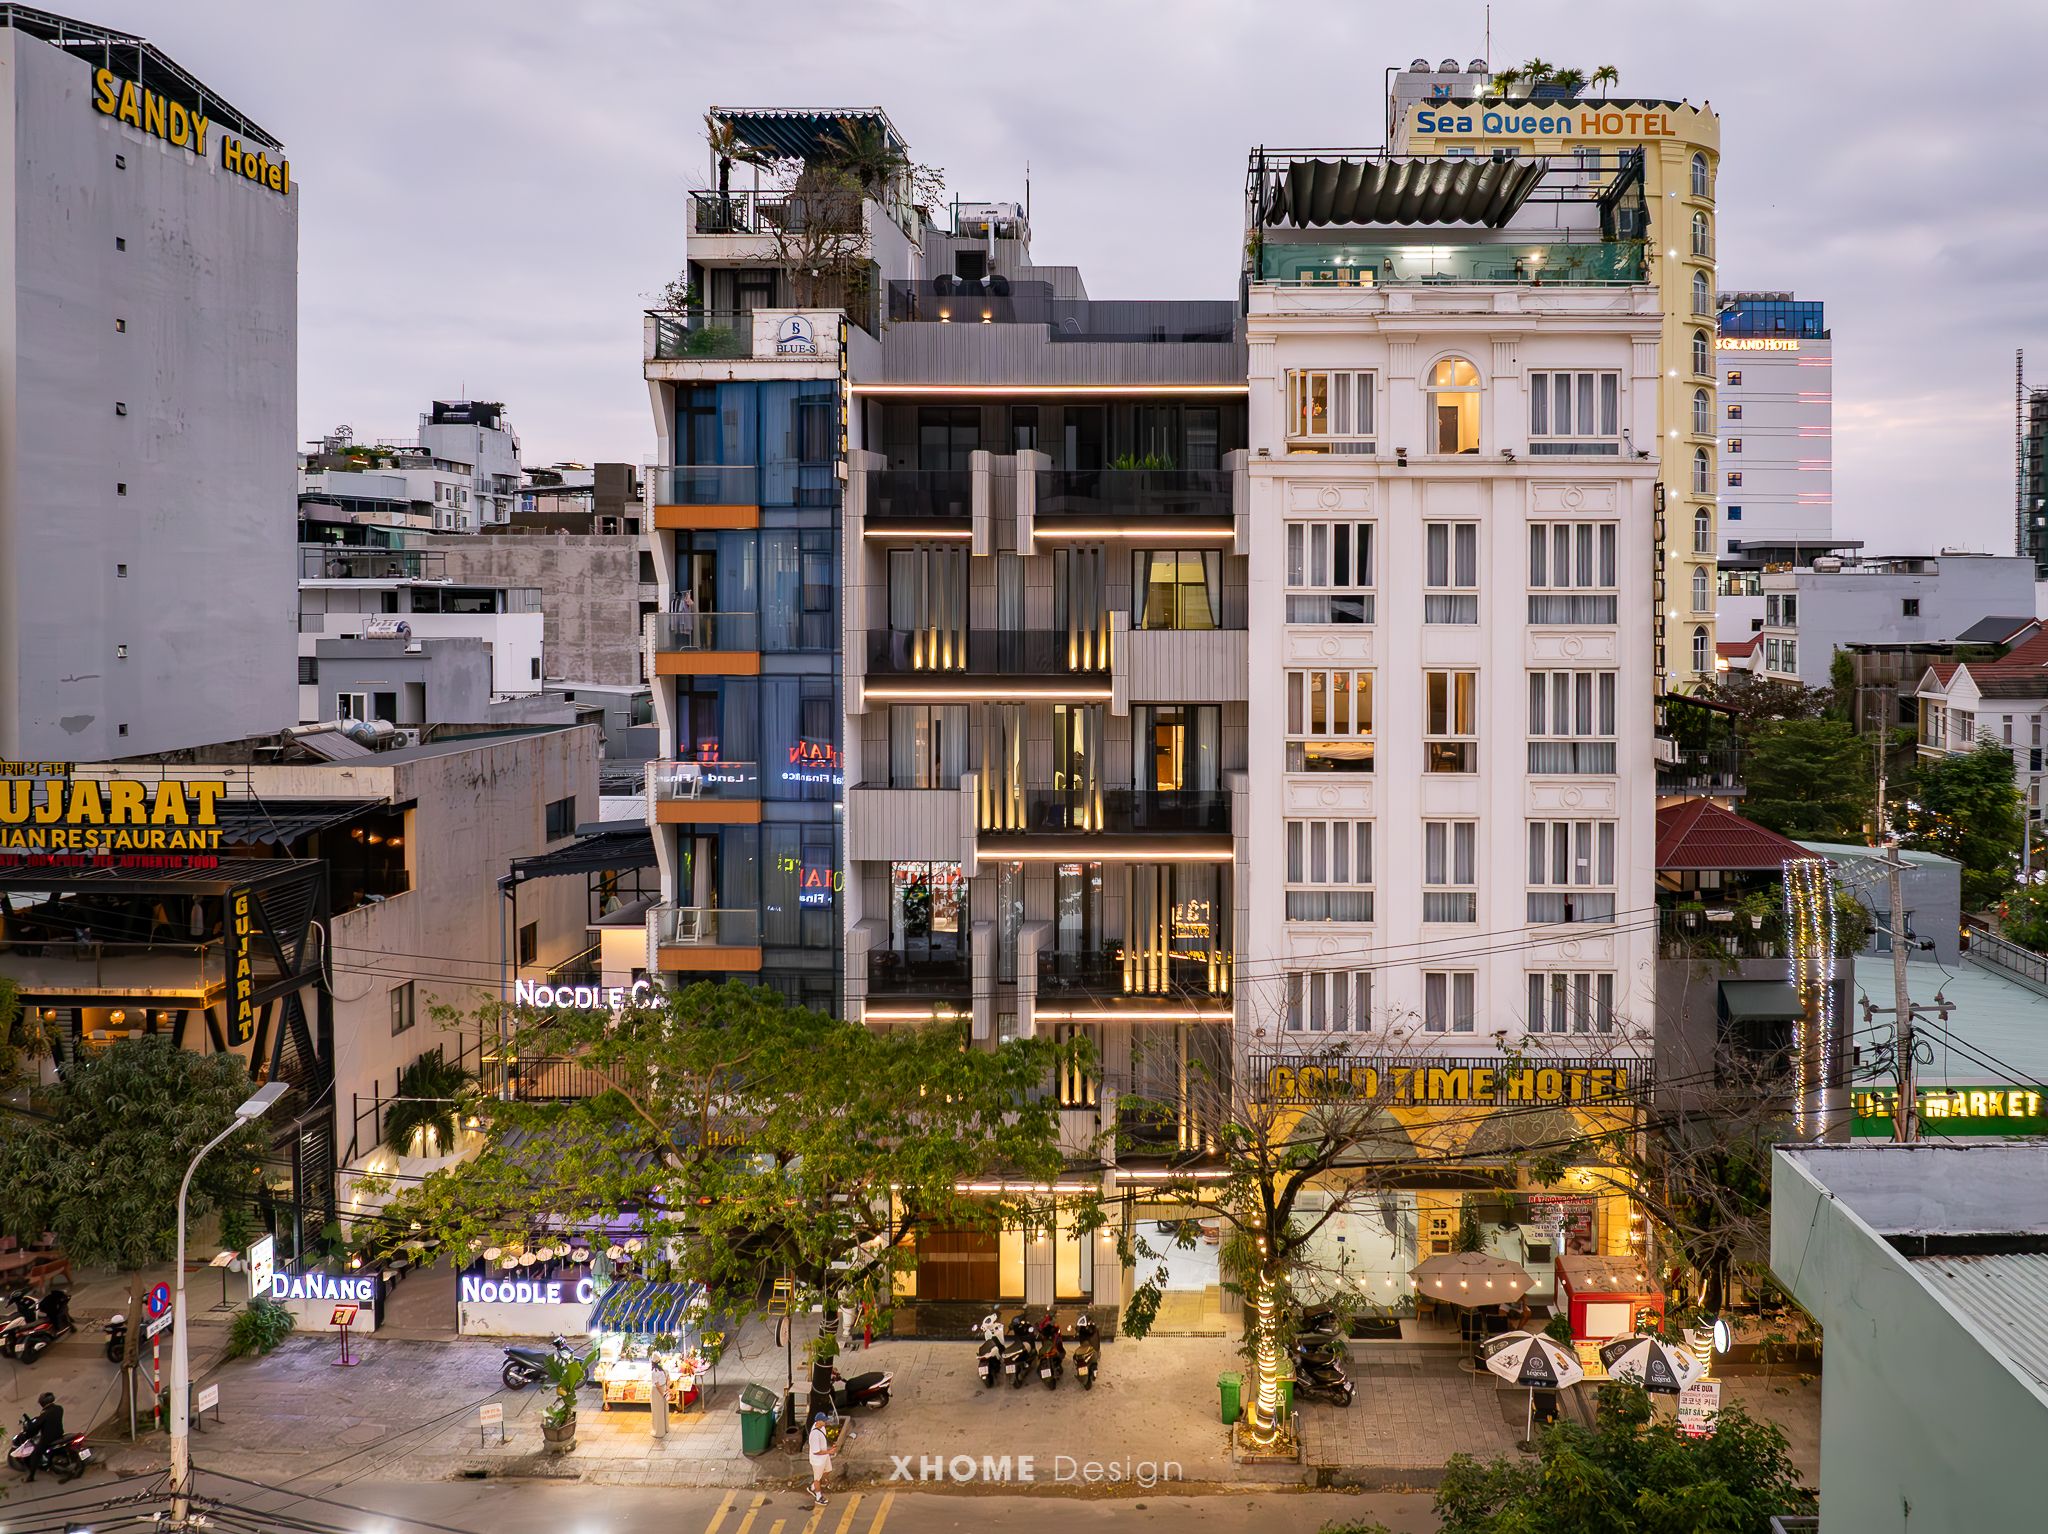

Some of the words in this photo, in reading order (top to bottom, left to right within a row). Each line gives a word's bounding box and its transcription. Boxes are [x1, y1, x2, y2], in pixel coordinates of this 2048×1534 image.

[97, 68, 208, 154] SANDY
[224, 135, 289, 194] Hotel
[1417, 111, 1472, 133] Sea
[1483, 112, 1571, 134] Queen
[1581, 113, 1675, 136] HOTEL
[776, 344, 816, 354] BLUE-S
[1722, 338, 1764, 350] GRAND
[1765, 339, 1799, 351] HOTEL
[52, 829, 223, 849] RESTAURANT
[235, 895, 251, 1040] GUJARAT
[1389, 1067, 1495, 1100] TIME
[1926, 1091, 2041, 1118] MARKET
[1433, 1219, 1447, 1229] 55
